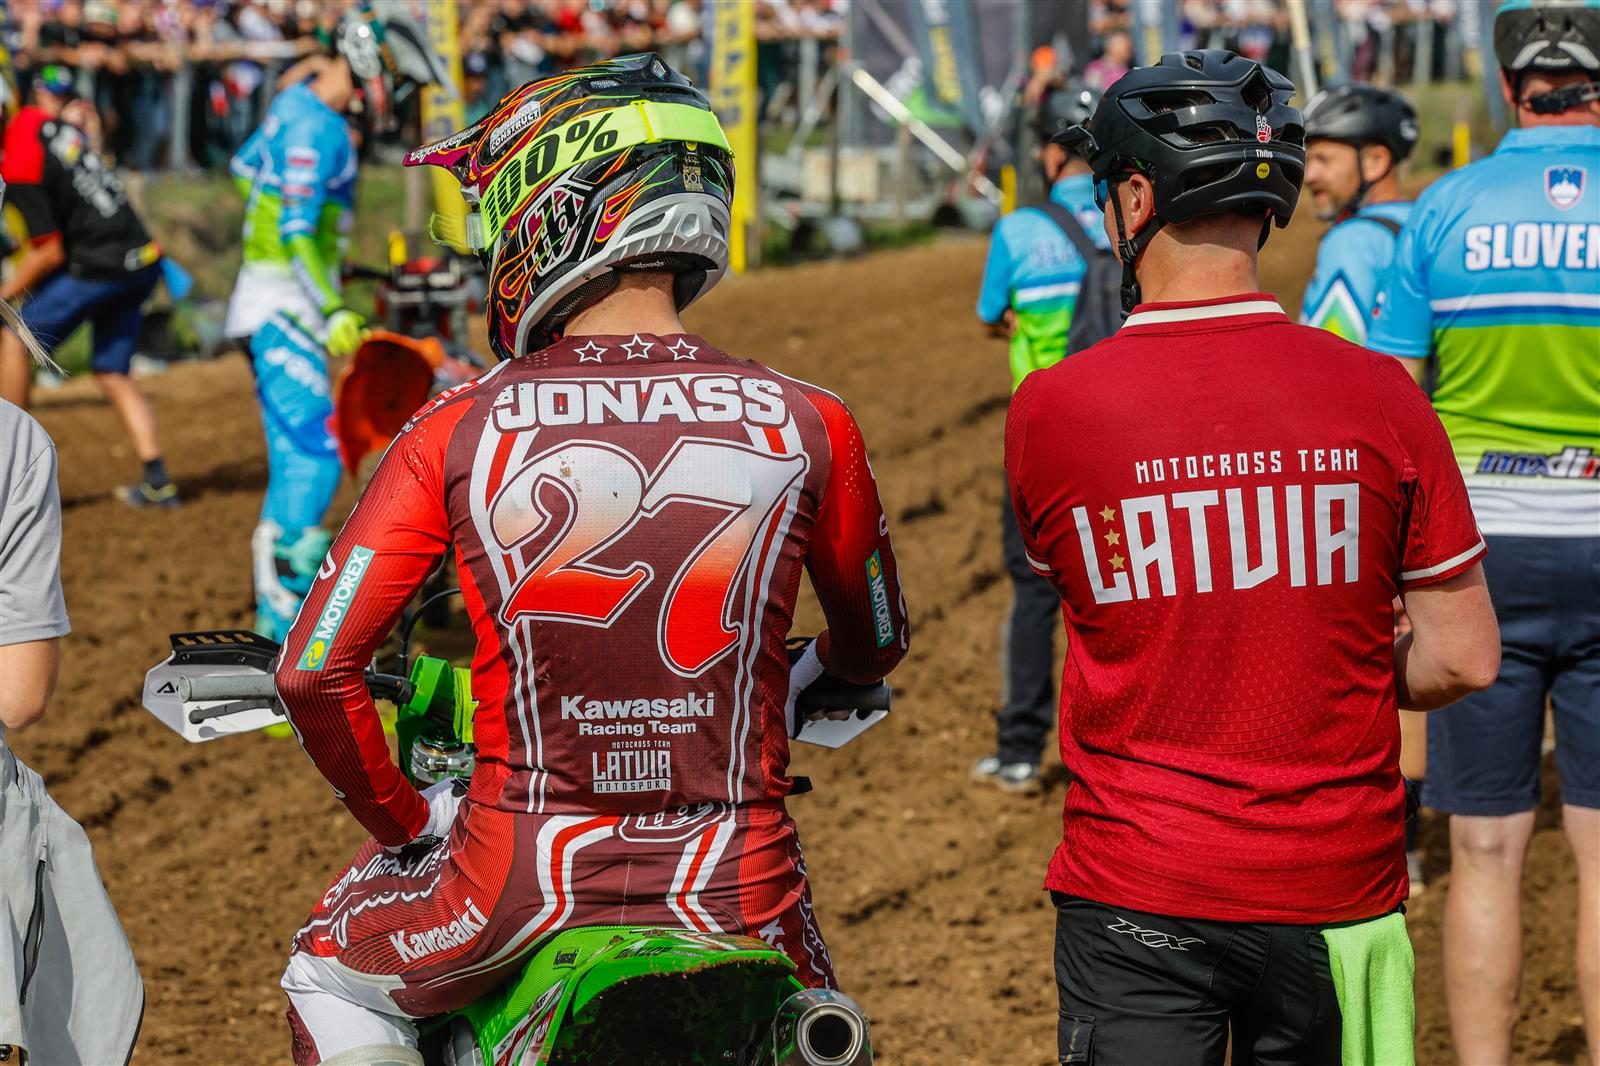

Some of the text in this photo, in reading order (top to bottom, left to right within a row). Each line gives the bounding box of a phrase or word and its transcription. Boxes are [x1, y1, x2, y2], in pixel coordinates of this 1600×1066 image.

[491, 110, 540, 152] CONSTRUCT
[484, 112, 618, 237] 100%
[494, 377, 786, 430] JONASS
[1135, 448, 1359, 484] MOTOCROSS TEAM
[490, 435, 810, 679] 27
[1072, 483, 1360, 605] LATVIA
[314, 552, 369, 640] MOTOREX
[871, 574, 893, 643] MOTOREX
[560, 692, 714, 720] Kawasaki
[578, 720, 697, 737] Racing Team
[592, 750, 671, 781] LATVIA
[611, 740, 671, 749] MOTOCROSS TEAM
[596, 779, 669, 792] MOTOSPORT
[388, 897, 488, 963] Kawasaki
